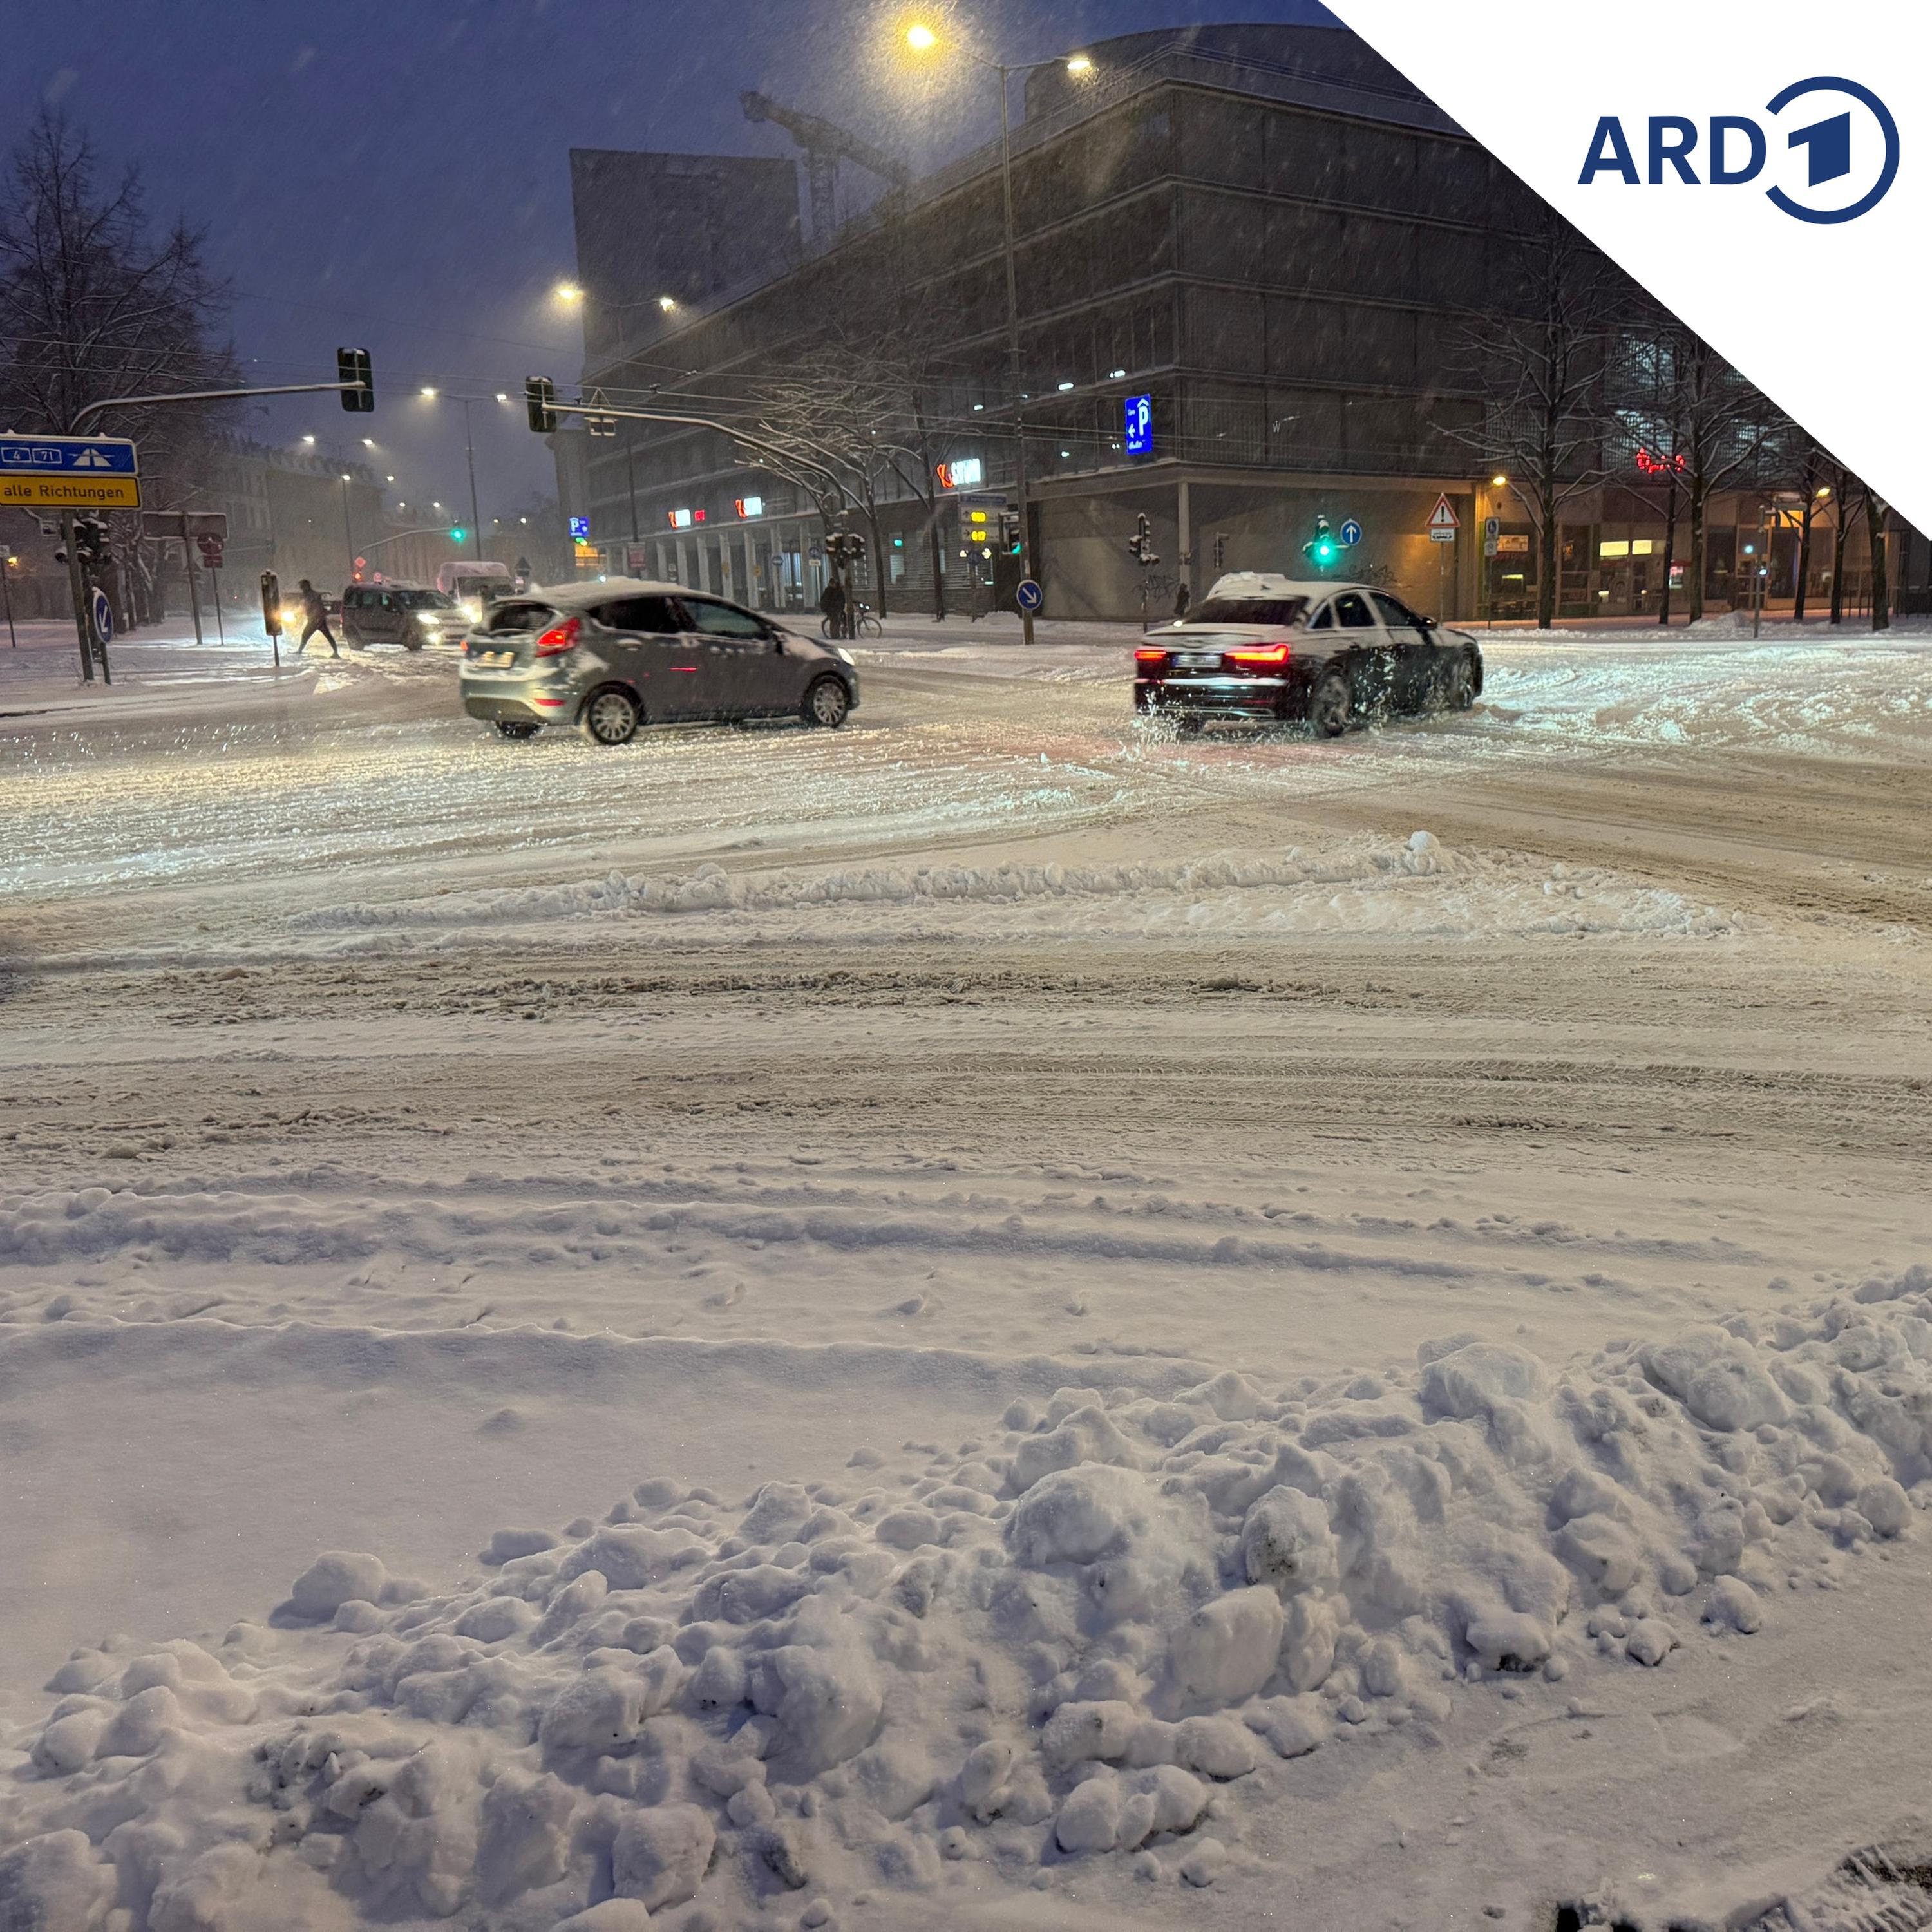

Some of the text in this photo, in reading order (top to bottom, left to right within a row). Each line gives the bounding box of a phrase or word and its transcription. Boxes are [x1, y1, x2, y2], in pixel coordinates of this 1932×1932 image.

[1139, 405, 1149, 437] P
[13, 451, 53, 461] 4 71
[4, 485, 124, 500] alle Richtungen
